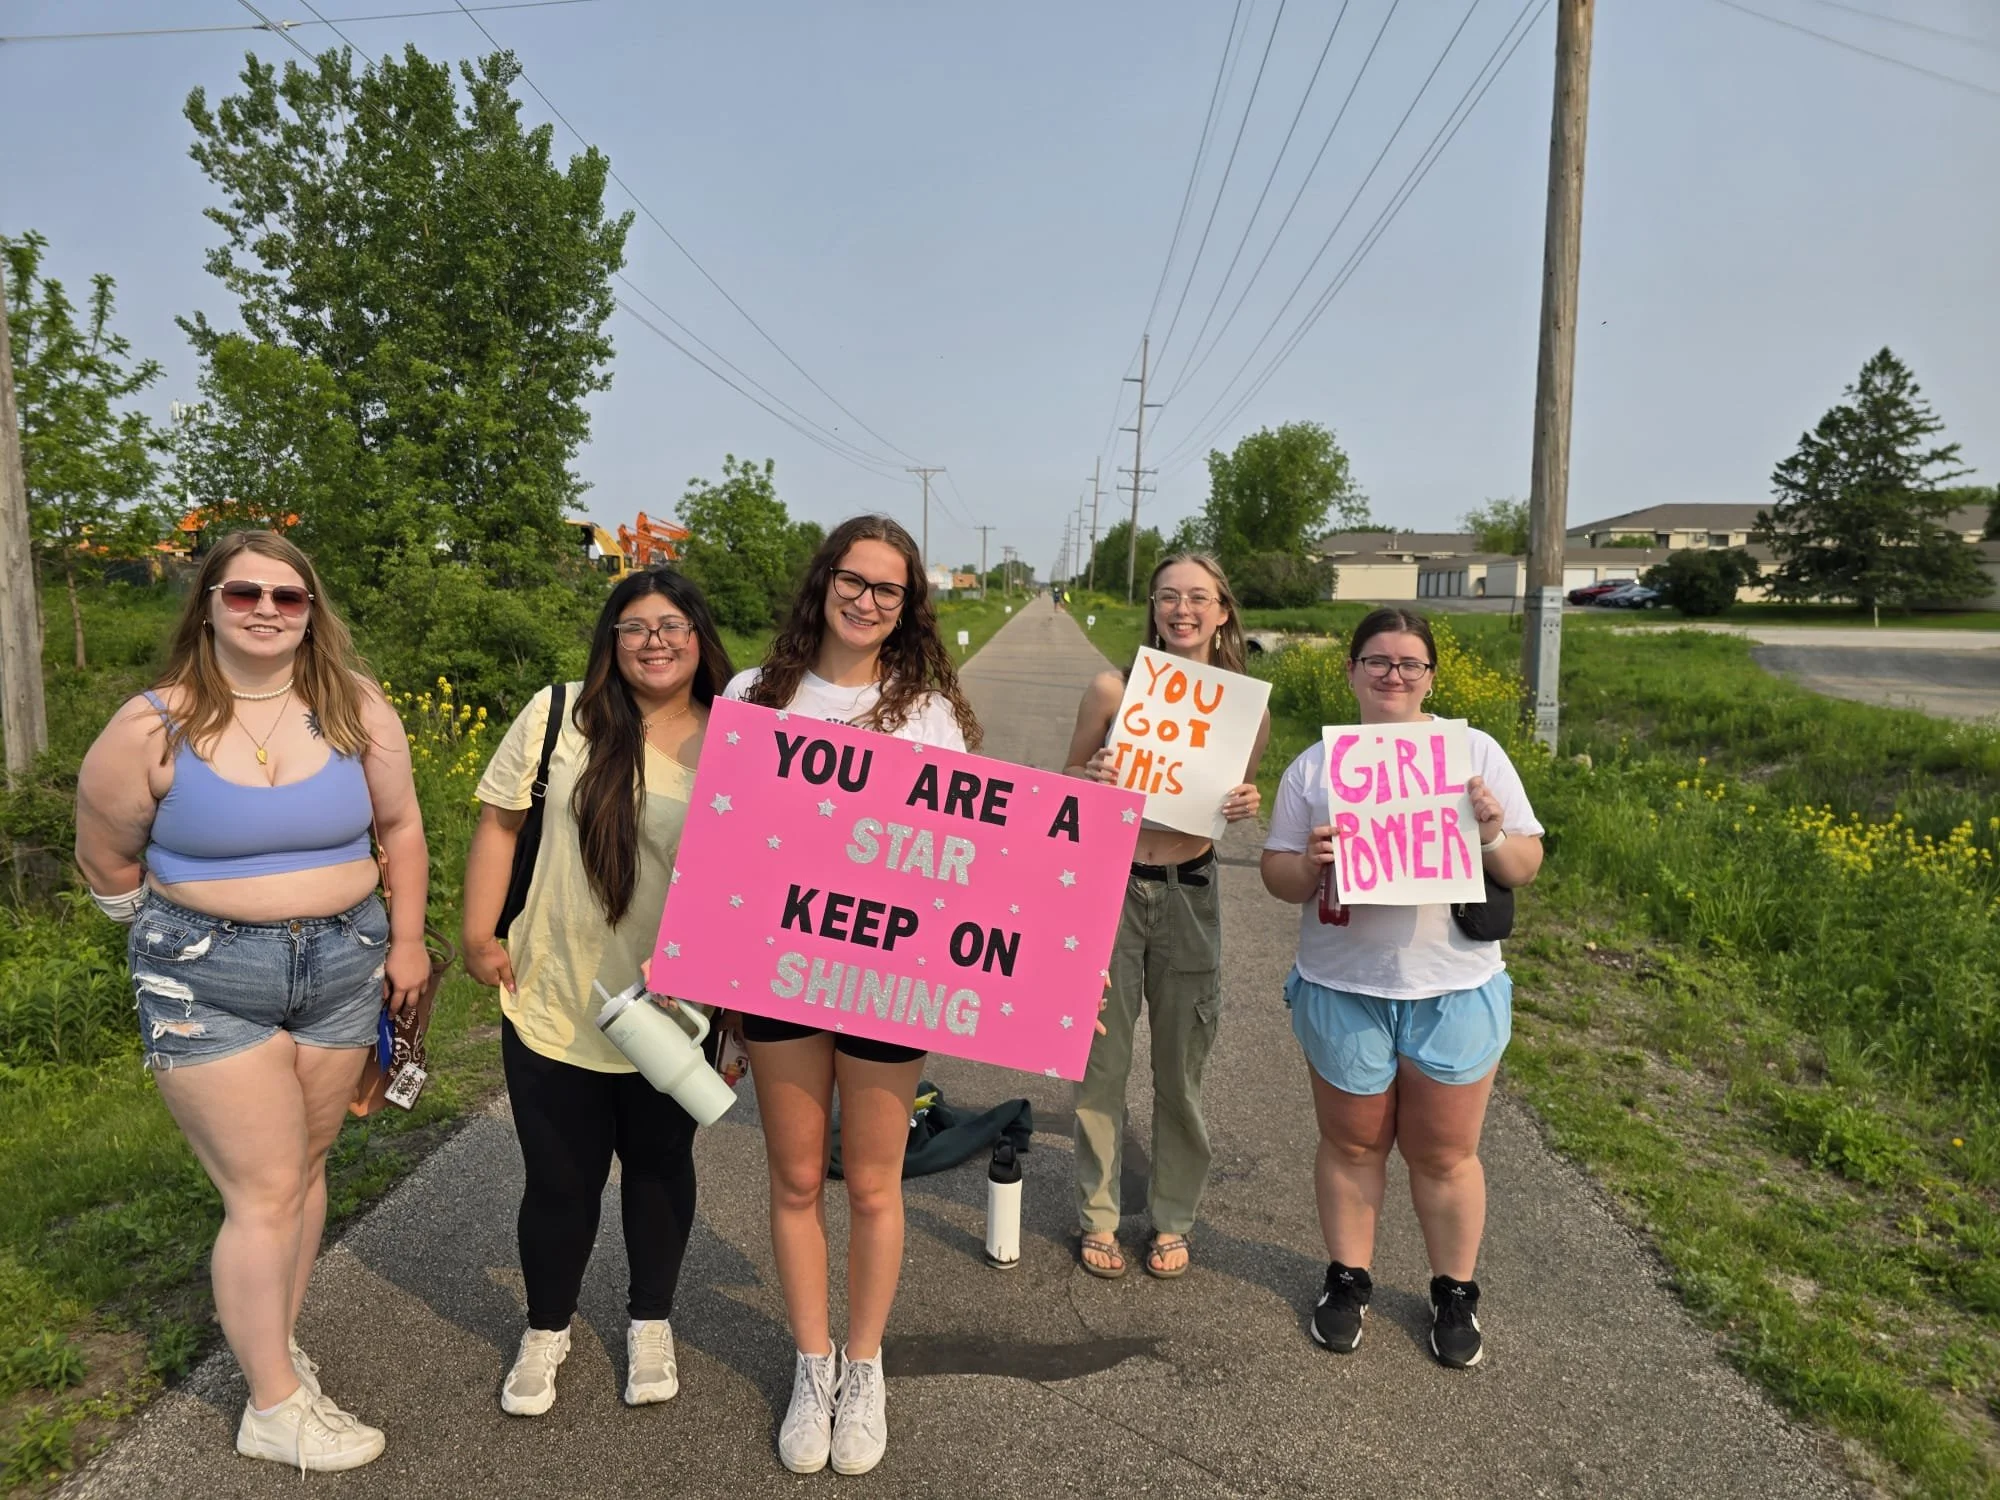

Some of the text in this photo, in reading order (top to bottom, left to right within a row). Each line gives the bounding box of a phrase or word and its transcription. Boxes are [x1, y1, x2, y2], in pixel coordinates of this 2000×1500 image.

[1144, 656, 1224, 714] YOU
[774, 731, 1081, 843] YOU ARE A
[846, 818, 976, 886] STAR
[1335, 807, 1473, 892] POWER
[780, 884, 1021, 977] KEEP ON
[770, 951, 980, 1037] SHINING
